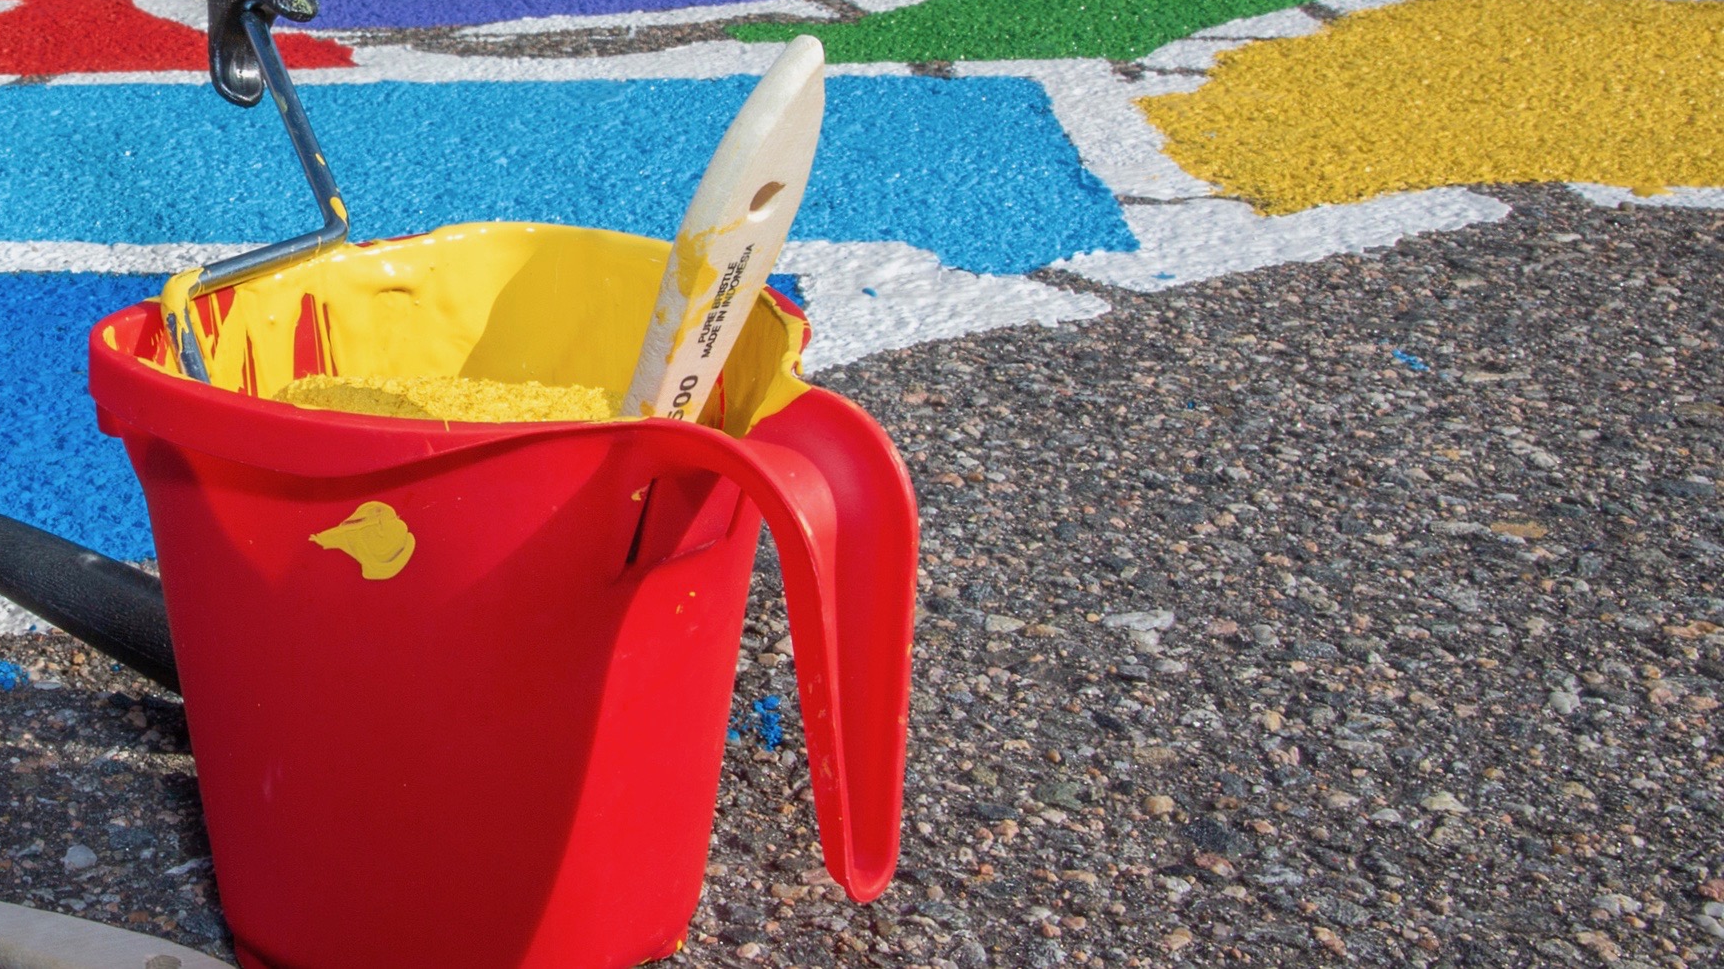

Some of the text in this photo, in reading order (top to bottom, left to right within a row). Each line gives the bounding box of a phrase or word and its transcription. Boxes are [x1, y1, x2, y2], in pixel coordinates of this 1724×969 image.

[698, 261, 738, 344] PURE BRISTLE
[701, 243, 755, 358] MADE IN INDONESIA
